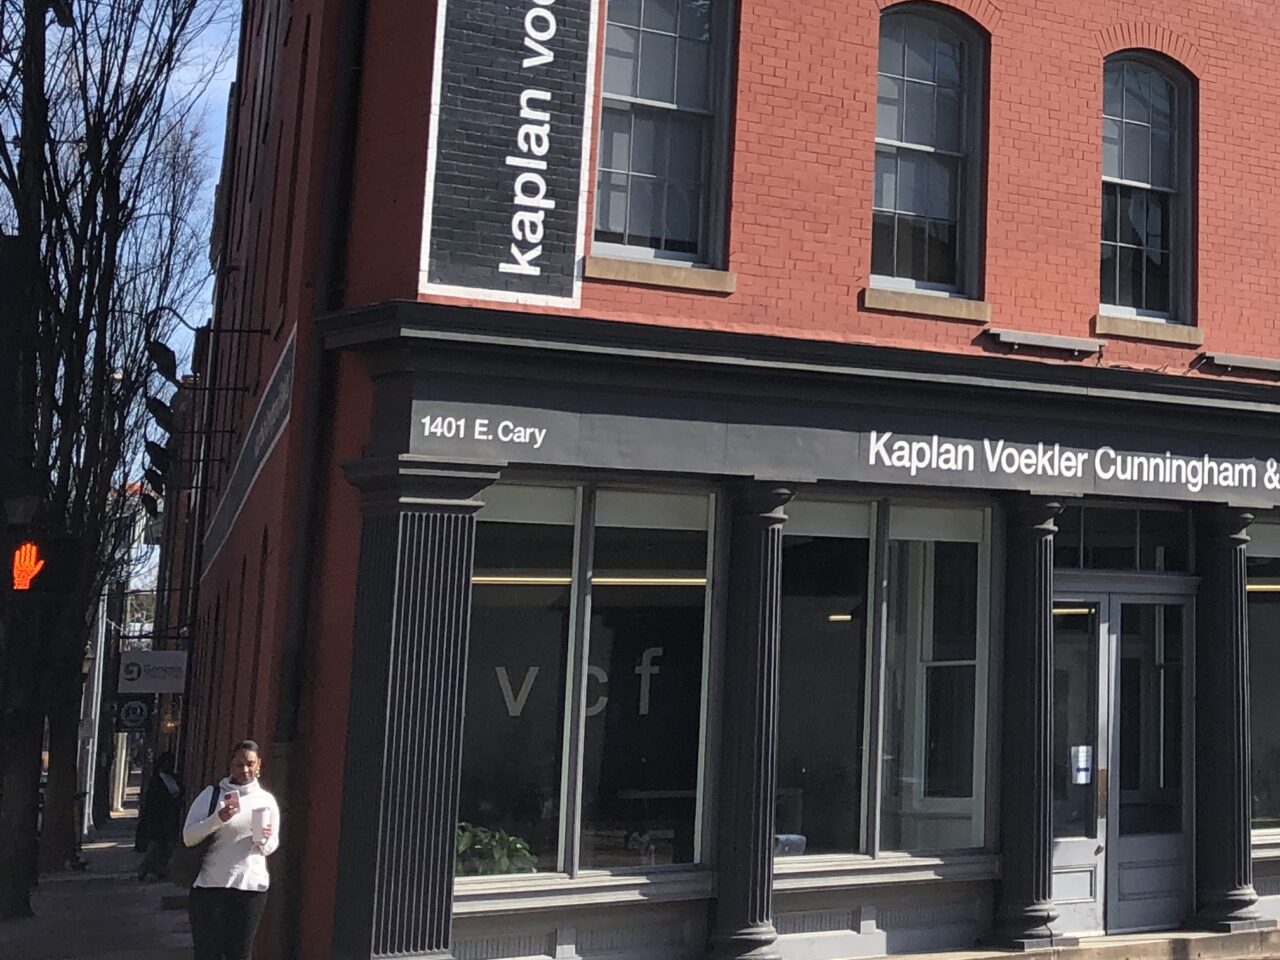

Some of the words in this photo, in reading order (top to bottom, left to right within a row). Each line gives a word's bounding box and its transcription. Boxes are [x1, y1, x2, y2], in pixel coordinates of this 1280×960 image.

[499, 89, 556, 276] kaplan
[421, 416, 466, 439] 1401
[474, 419, 493, 440] E.
[498, 421, 546, 448] Cary
[869, 431, 974, 476] Kaplan
[983, 439, 1088, 478] Voekler
[1095, 446, 1257, 493] Cunningham
